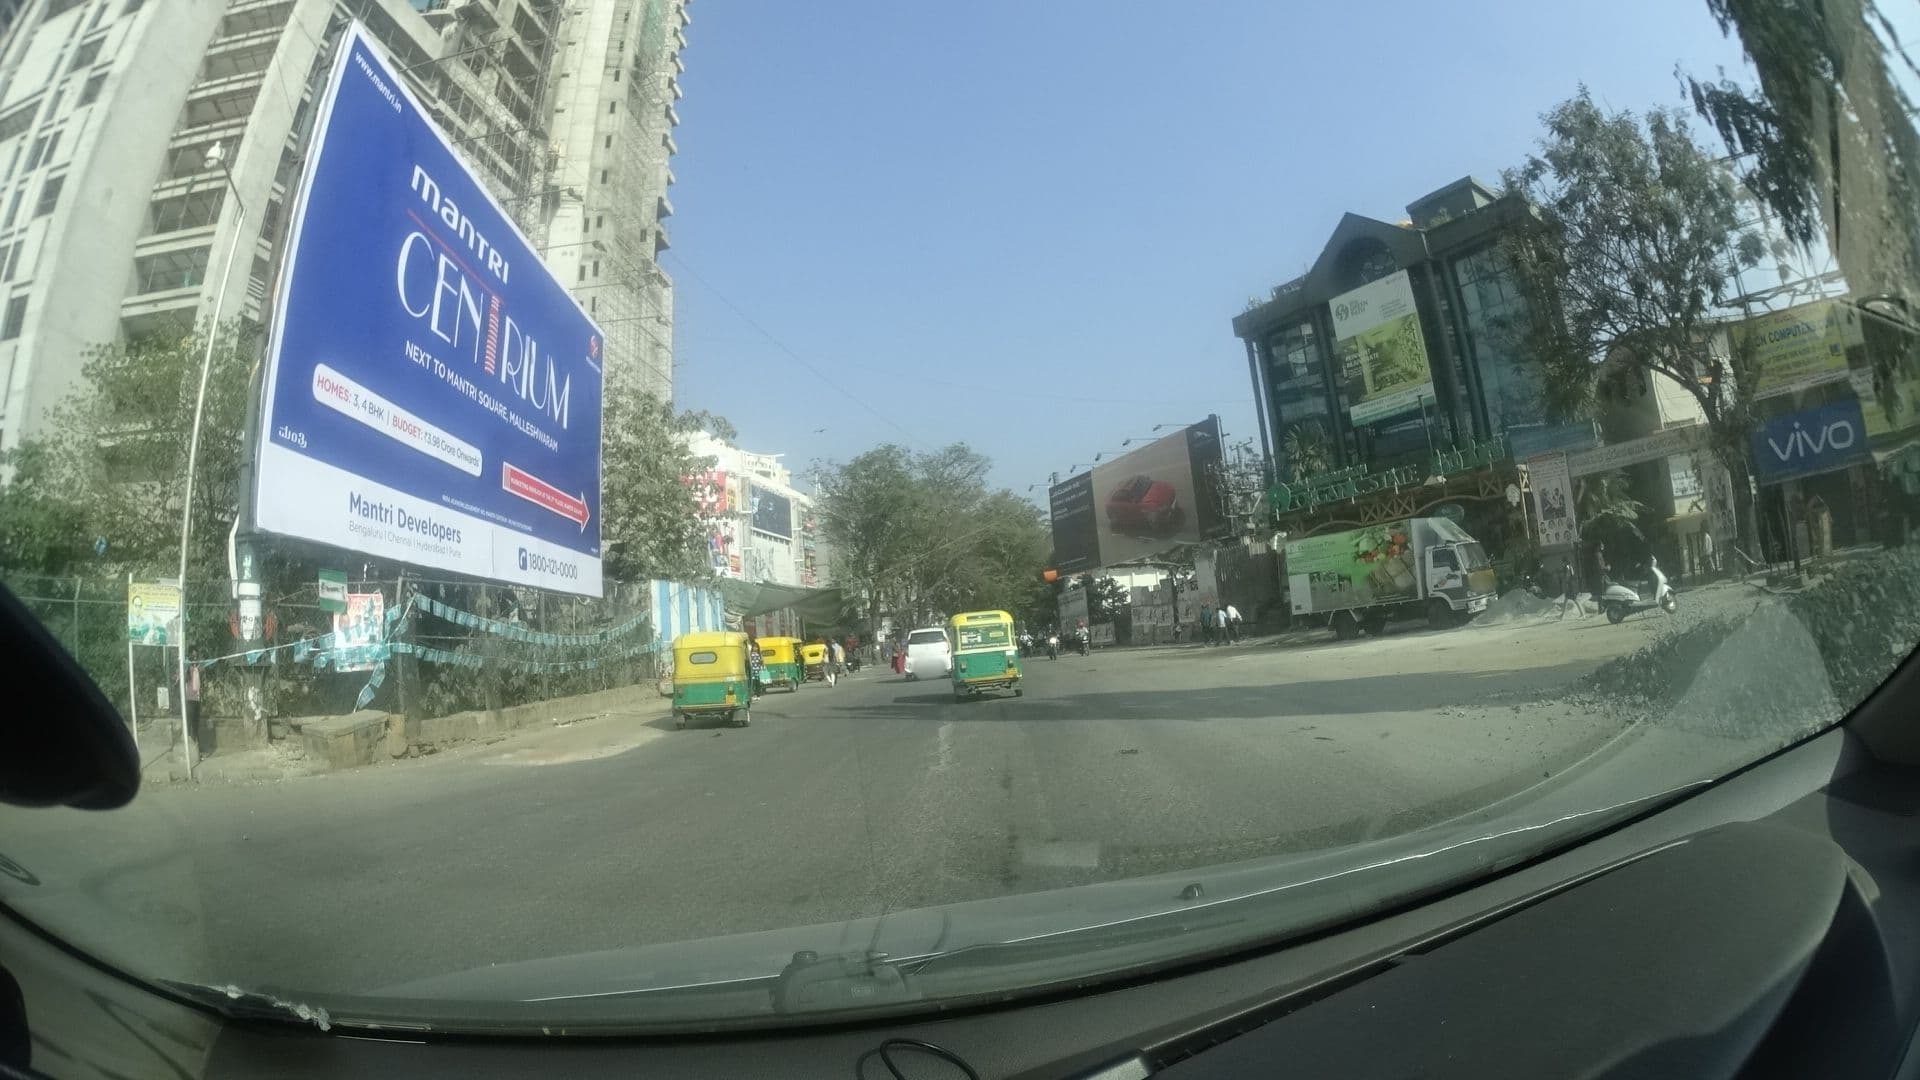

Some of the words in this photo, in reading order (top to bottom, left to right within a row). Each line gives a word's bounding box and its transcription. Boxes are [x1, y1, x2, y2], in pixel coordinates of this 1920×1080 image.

[355, 52, 402, 114] www.mantri.in
[397, 231, 570, 430] CENTRIUM
[316, 375, 352, 402] HOMES:
[353, 394, 361, 410] 3,
[361, 400, 368, 412] 4
[368, 400, 385, 420] BHK
[405, 340, 431, 370] NEXT
[434, 358, 446, 378] TO
[446, 368, 477, 401] MANTRI
[478, 391, 509, 422] SQUARE,
[509, 410, 558, 453] MALLESHWARAM
[392, 415, 424, 441] BUDGET:
[441, 437, 456, 457] Crore
[456, 447, 480, 468] Onwards
[349, 491, 393, 525] Mantri
[398, 507, 462, 544] Developers
[349, 520, 384, 540] Bengaluru
[529, 552, 578, 580] 1800-121-0000
